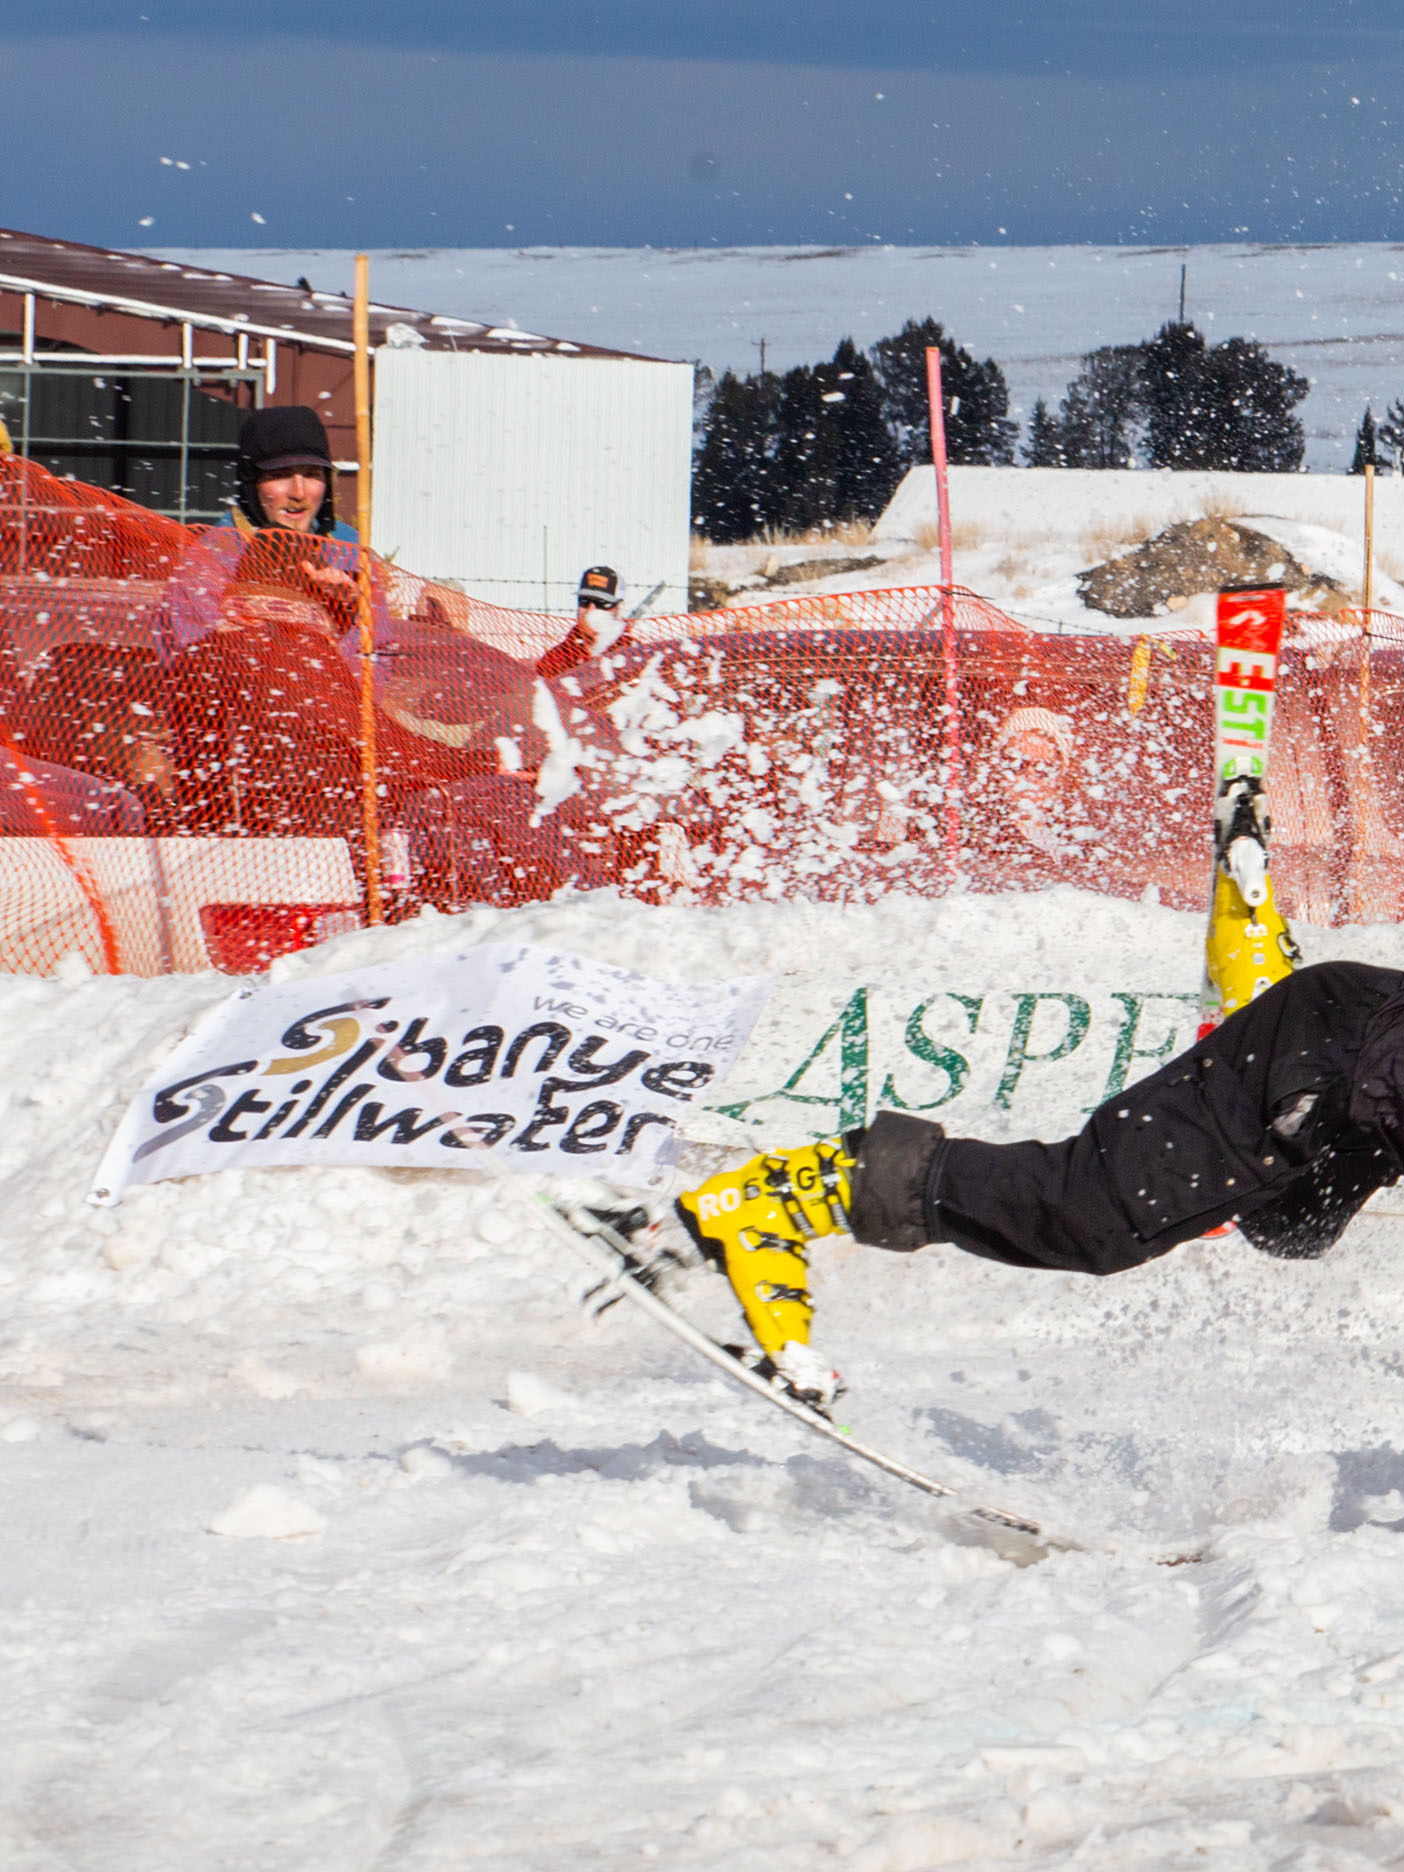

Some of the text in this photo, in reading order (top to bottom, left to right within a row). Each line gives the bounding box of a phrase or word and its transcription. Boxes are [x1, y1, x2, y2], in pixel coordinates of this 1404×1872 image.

[262, 996, 716, 1101] Sibanye
[533, 996, 735, 1051] we are one
[702, 987, 1202, 1138] ASPE
[132, 1058, 678, 1164] Stillwater
